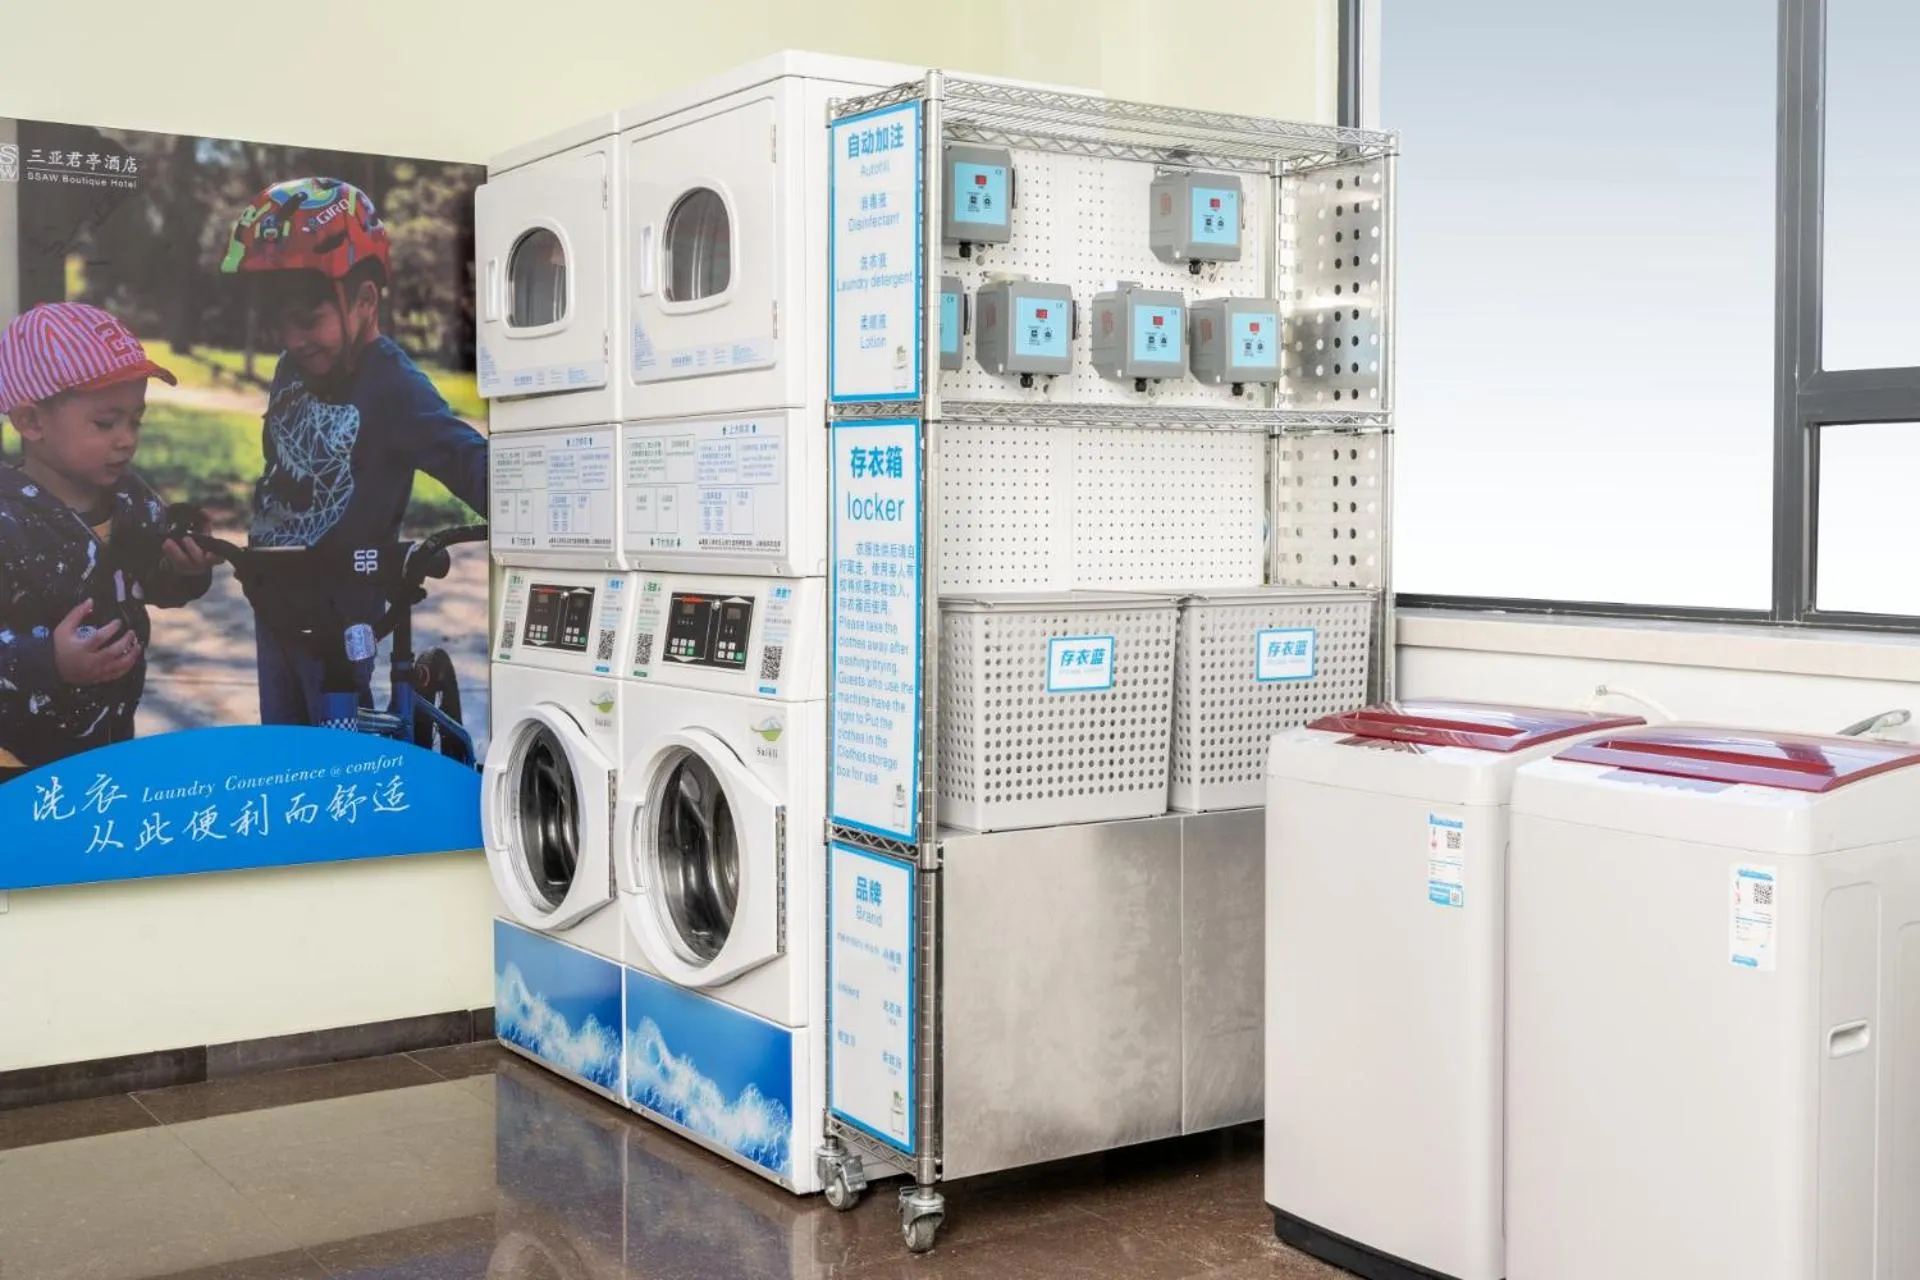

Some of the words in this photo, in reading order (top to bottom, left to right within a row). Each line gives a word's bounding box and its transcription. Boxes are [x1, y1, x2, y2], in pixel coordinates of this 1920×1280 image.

[848, 122, 904, 159] 自动加注
[27, 149, 138, 173] 三亚君亭酒店
[62, 174, 107, 188] Boutique
[110, 179, 137, 189] Hotel
[316, 198, 351, 225] GIRO
[836, 278, 868, 292] Laundry
[871, 271, 913, 289] detergent
[850, 445, 903, 479] 存衣箱
[847, 491, 905, 522] locker
[885, 621, 898, 634] the
[143, 781, 215, 803] Laundry
[225, 767, 326, 791] Convenience
[346, 754, 404, 775] comfort
[33, 774, 128, 821] 洗衣
[86, 774, 411, 854] 从此便利而舒适
[855, 875, 882, 906] 品牌
[855, 905, 882, 928] Brand
